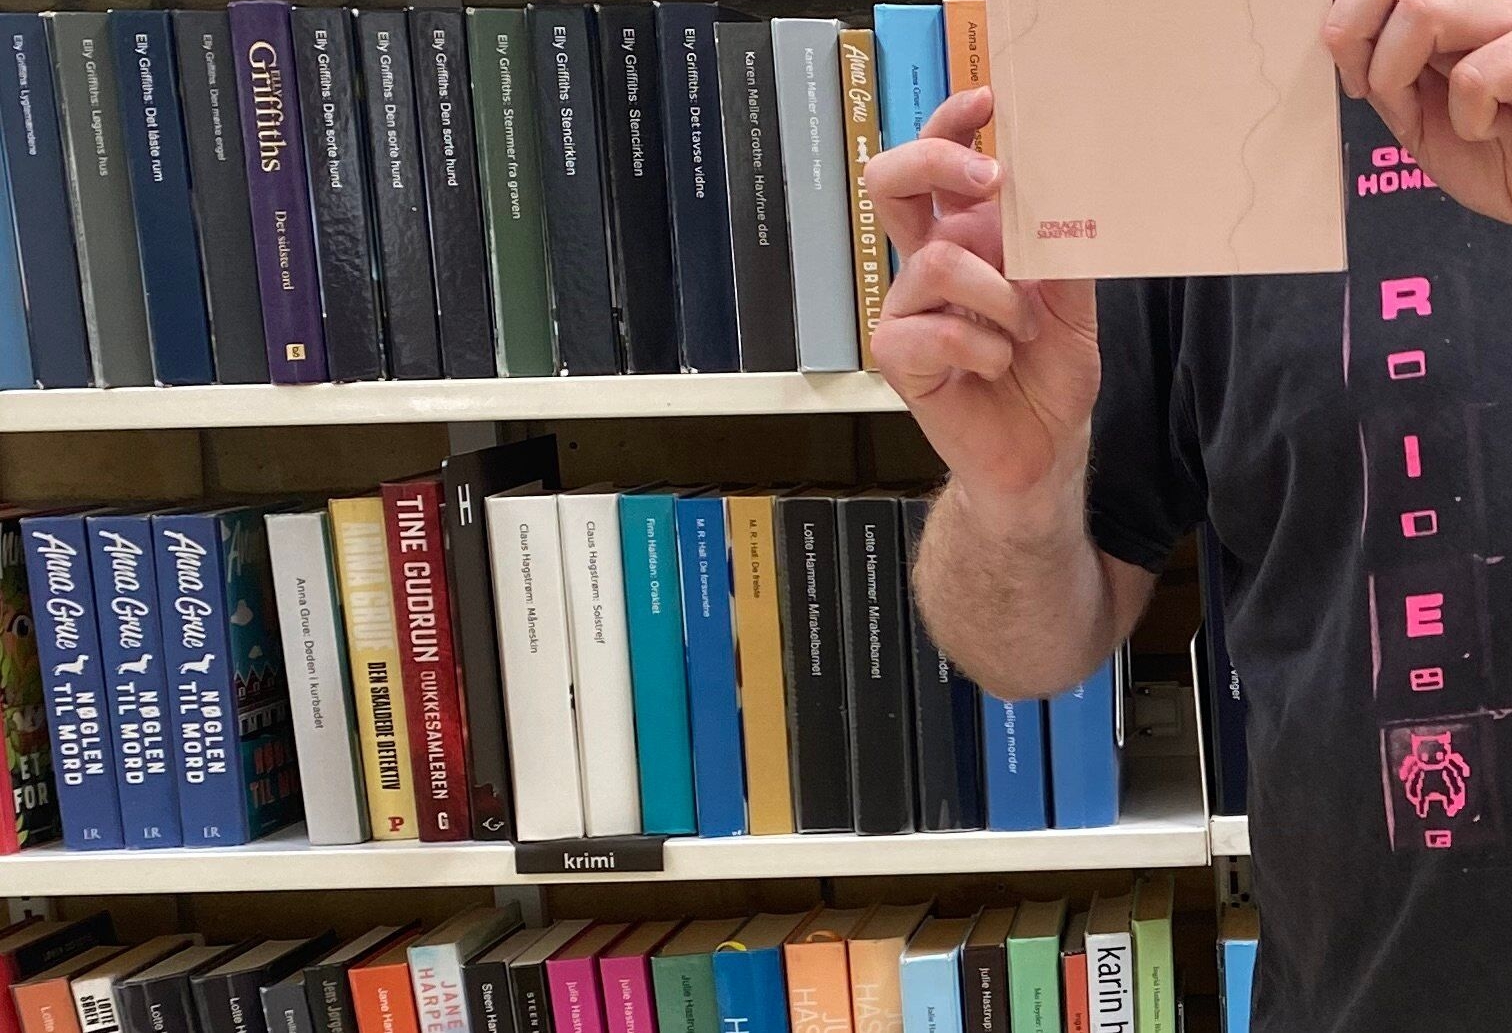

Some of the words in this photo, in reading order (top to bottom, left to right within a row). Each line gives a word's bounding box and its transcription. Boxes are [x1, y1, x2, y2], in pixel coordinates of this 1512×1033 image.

[744, 50, 757, 80] Karen
[843, 43, 869, 85] Anna
[134, 33, 147, 55] Elly
[144, 107, 156, 127] Det
[151, 160, 163, 182] rum
[248, 40, 287, 173] Griffiths
[747, 81, 759, 125] Møller
[847, 86, 871, 124] Grue
[274, 210, 288, 232] Det
[754, 174, 767, 221] Havfrue
[277, 234, 291, 267] sidste
[758, 223, 770, 246] død
[281, 268, 294, 291] ord
[1381, 277, 1431, 320] R
[396, 495, 427, 553] TINE
[803, 523, 814, 555] Lotte
[31, 530, 77, 595] Anna
[98, 530, 143, 594] Anna
[163, 530, 207, 594] Anna
[519, 523, 529, 552] Claus
[527, 607, 538, 654] Måneskin
[46, 597, 84, 650] Grue
[111, 597, 149, 649] Grue
[174, 596, 213, 649] Grue
[403, 561, 440, 663] GUDRUN
[1405, 593, 1443, 638] E
[808, 603, 821, 676] Mirakelbarnet
[53, 683, 73, 716] TIL
[116, 681, 137, 714] TIL
[178, 681, 197, 714] TIL
[58, 724, 83, 786] MORD
[75, 690, 104, 775] NØGLEN
[120, 723, 145, 785] MORD
[138, 690, 166, 774] NØGLEN
[181, 722, 206, 784] MORD
[200, 690, 226, 774] NØGLEN
[420, 670, 449, 800] DUKKESAMLEREN
[563, 852, 616, 871] krimi
[1096, 946, 1132, 1015] karin
